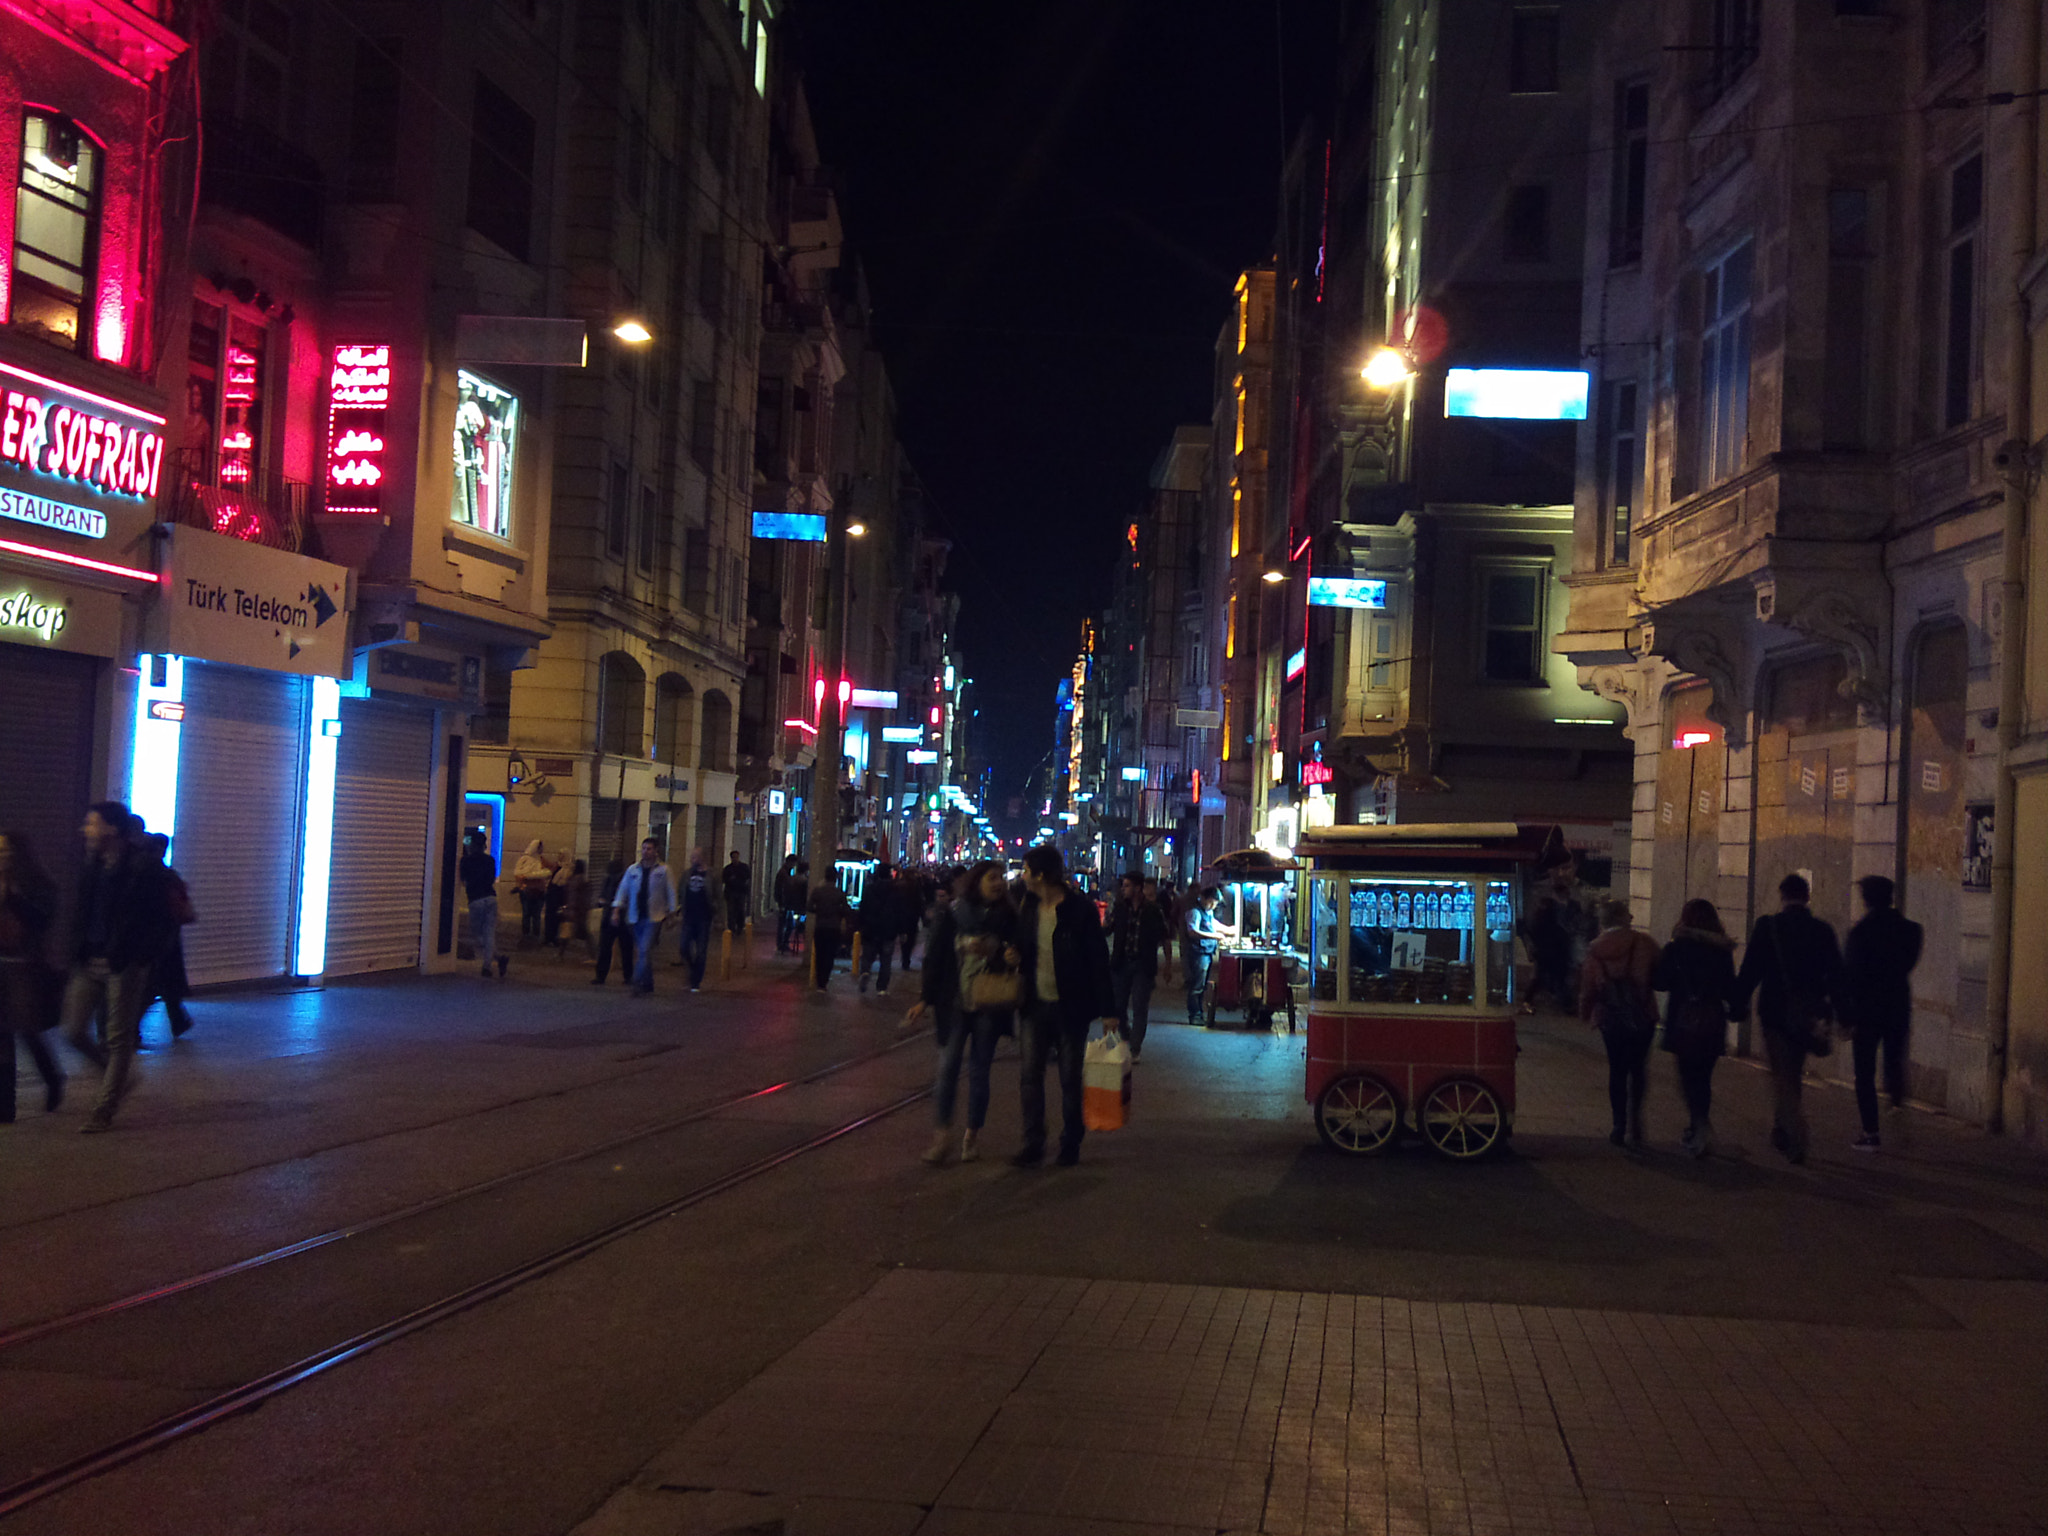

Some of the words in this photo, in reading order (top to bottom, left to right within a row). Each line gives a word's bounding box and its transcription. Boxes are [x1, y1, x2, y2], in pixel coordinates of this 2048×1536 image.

[0, 386, 46, 470] ER
[0, 492, 104, 535] STAURANT
[187, 578, 227, 613] Türk
[234, 588, 308, 628] Telekom
